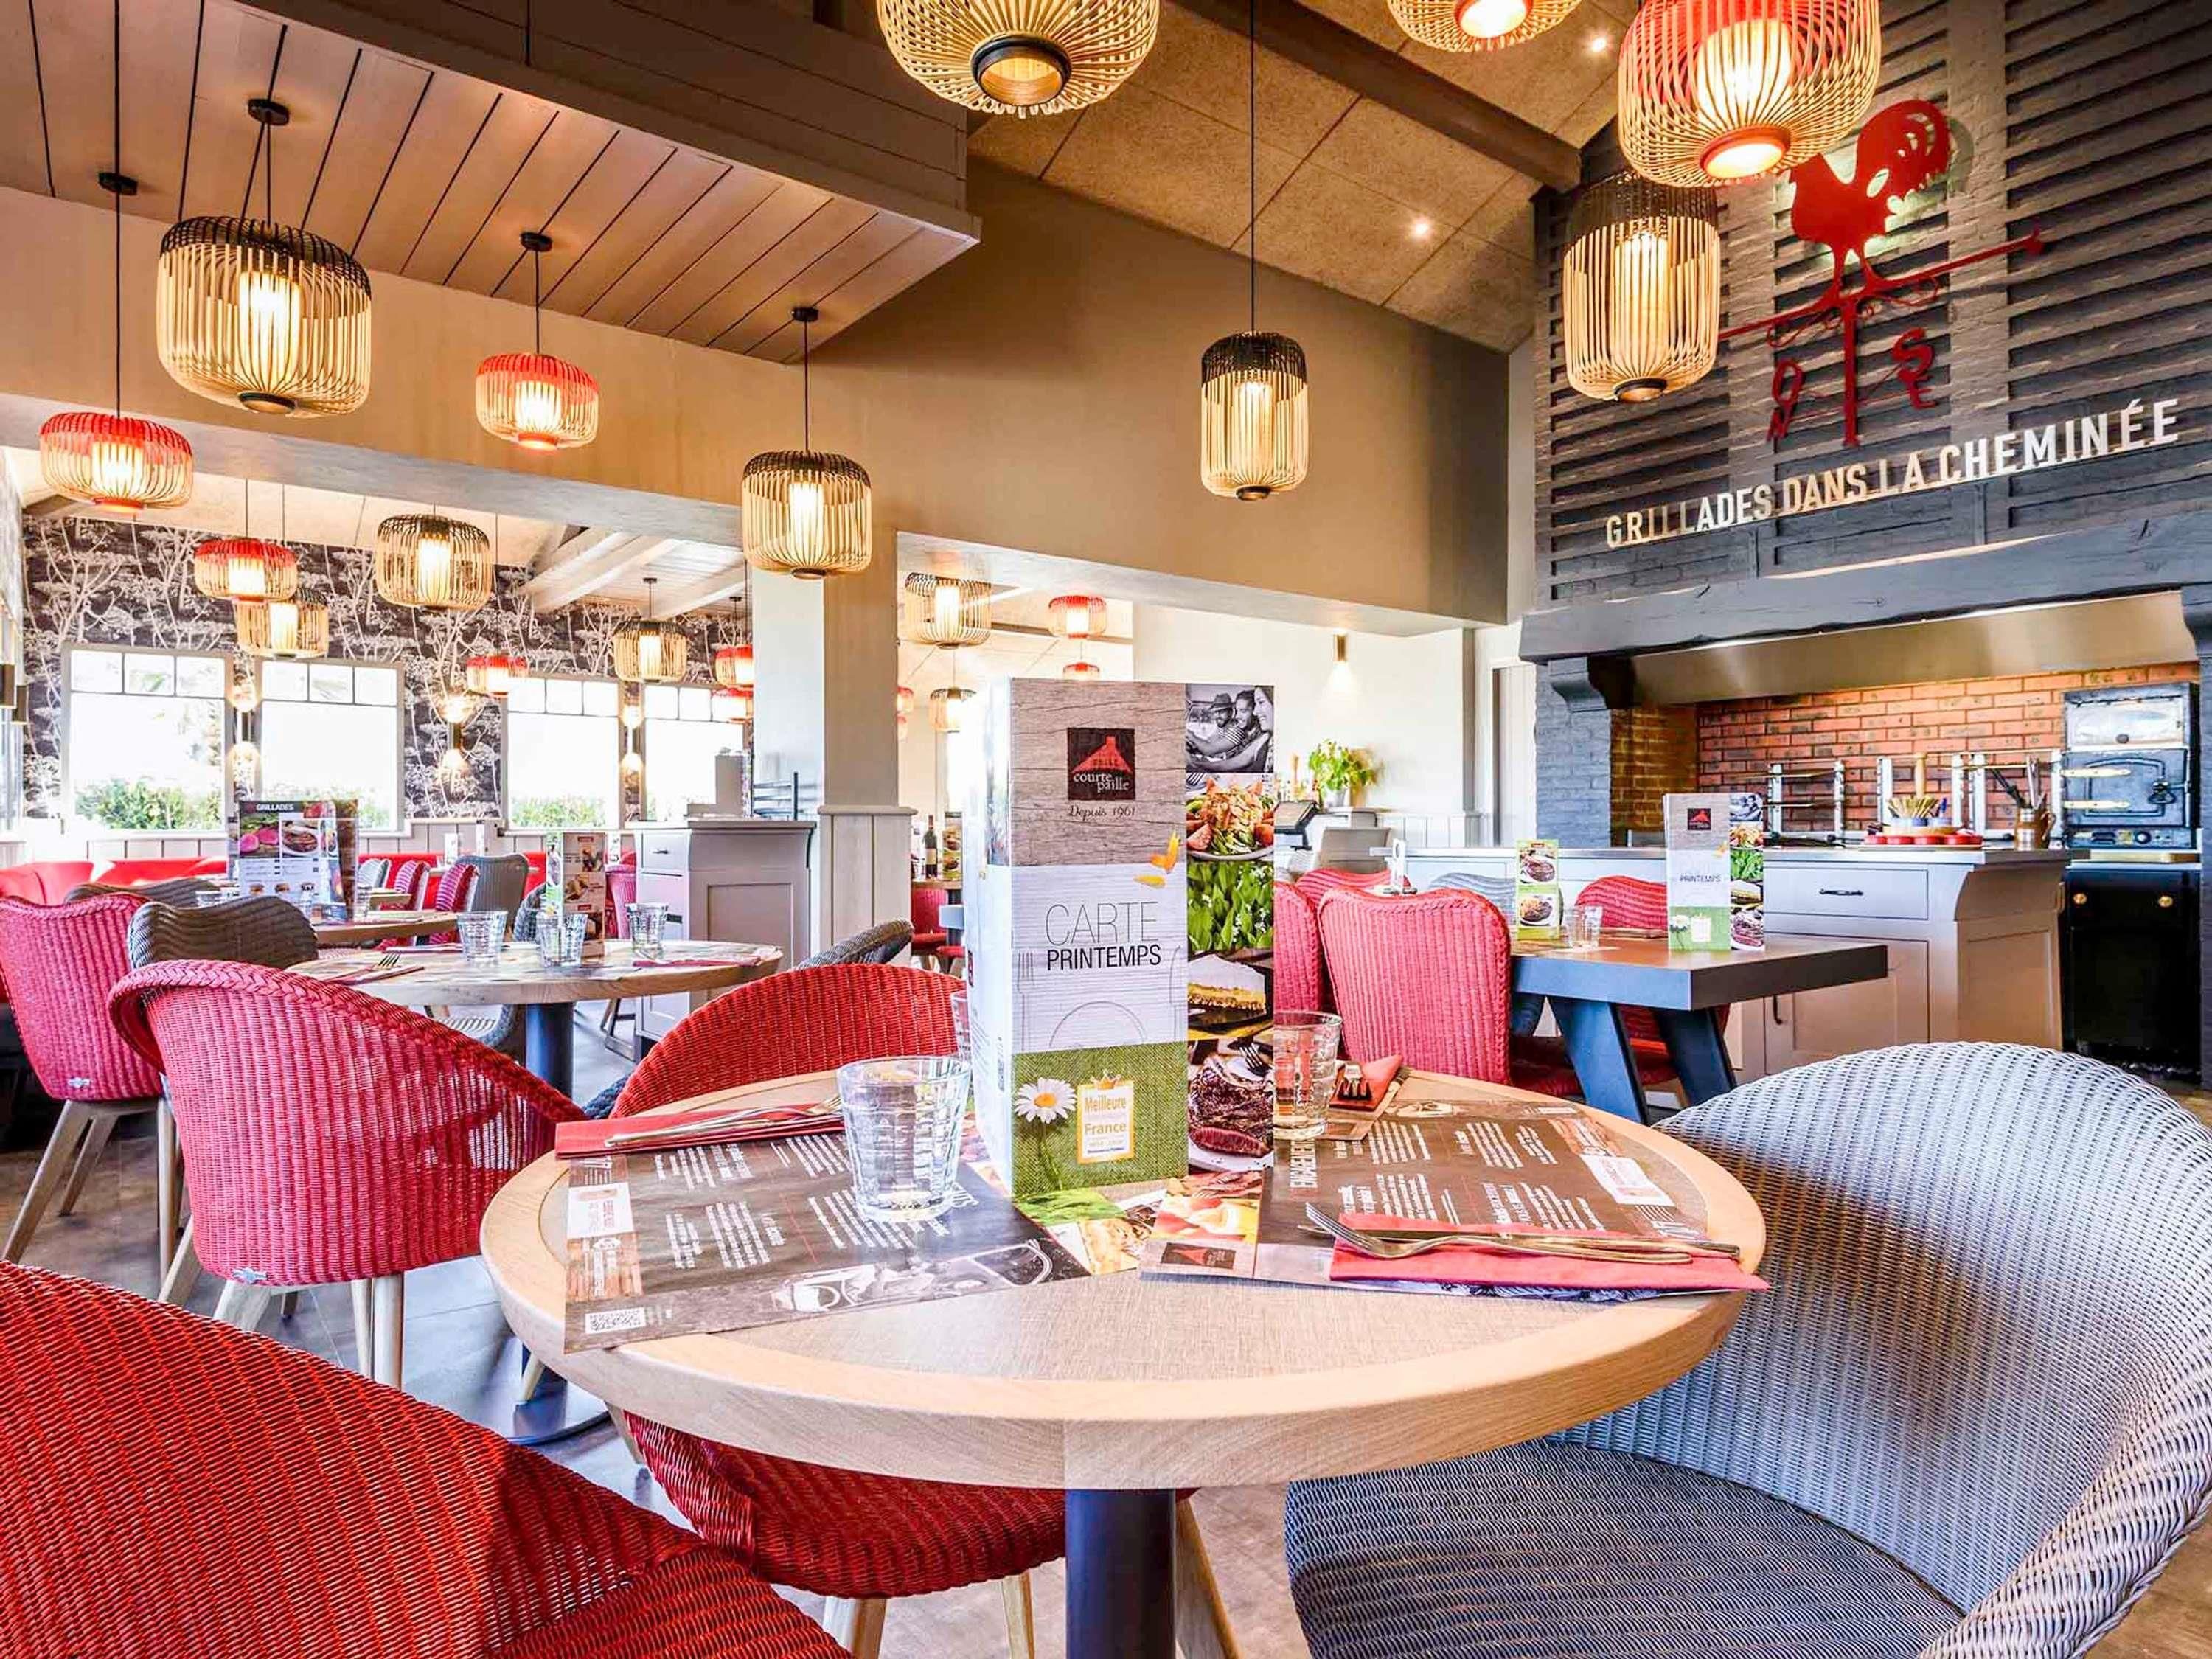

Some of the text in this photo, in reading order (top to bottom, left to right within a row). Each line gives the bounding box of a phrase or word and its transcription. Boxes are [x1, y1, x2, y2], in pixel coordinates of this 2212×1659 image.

[1607, 398, 2180, 548] GRILLADES DANS LA CHEMINÉE
[1073, 772, 1113, 782] courte
[1097, 776, 1130, 793] paille
[257, 803, 294, 811] GRILLADES
[1068, 804, 1135, 821] Depuis 1961
[1045, 901, 1159, 947] CARTE
[1046, 943, 1161, 972] PRINTEMPS
[1085, 1122, 1127, 1135] France
[1290, 1138, 1318, 1189] ENGAGEMENT
